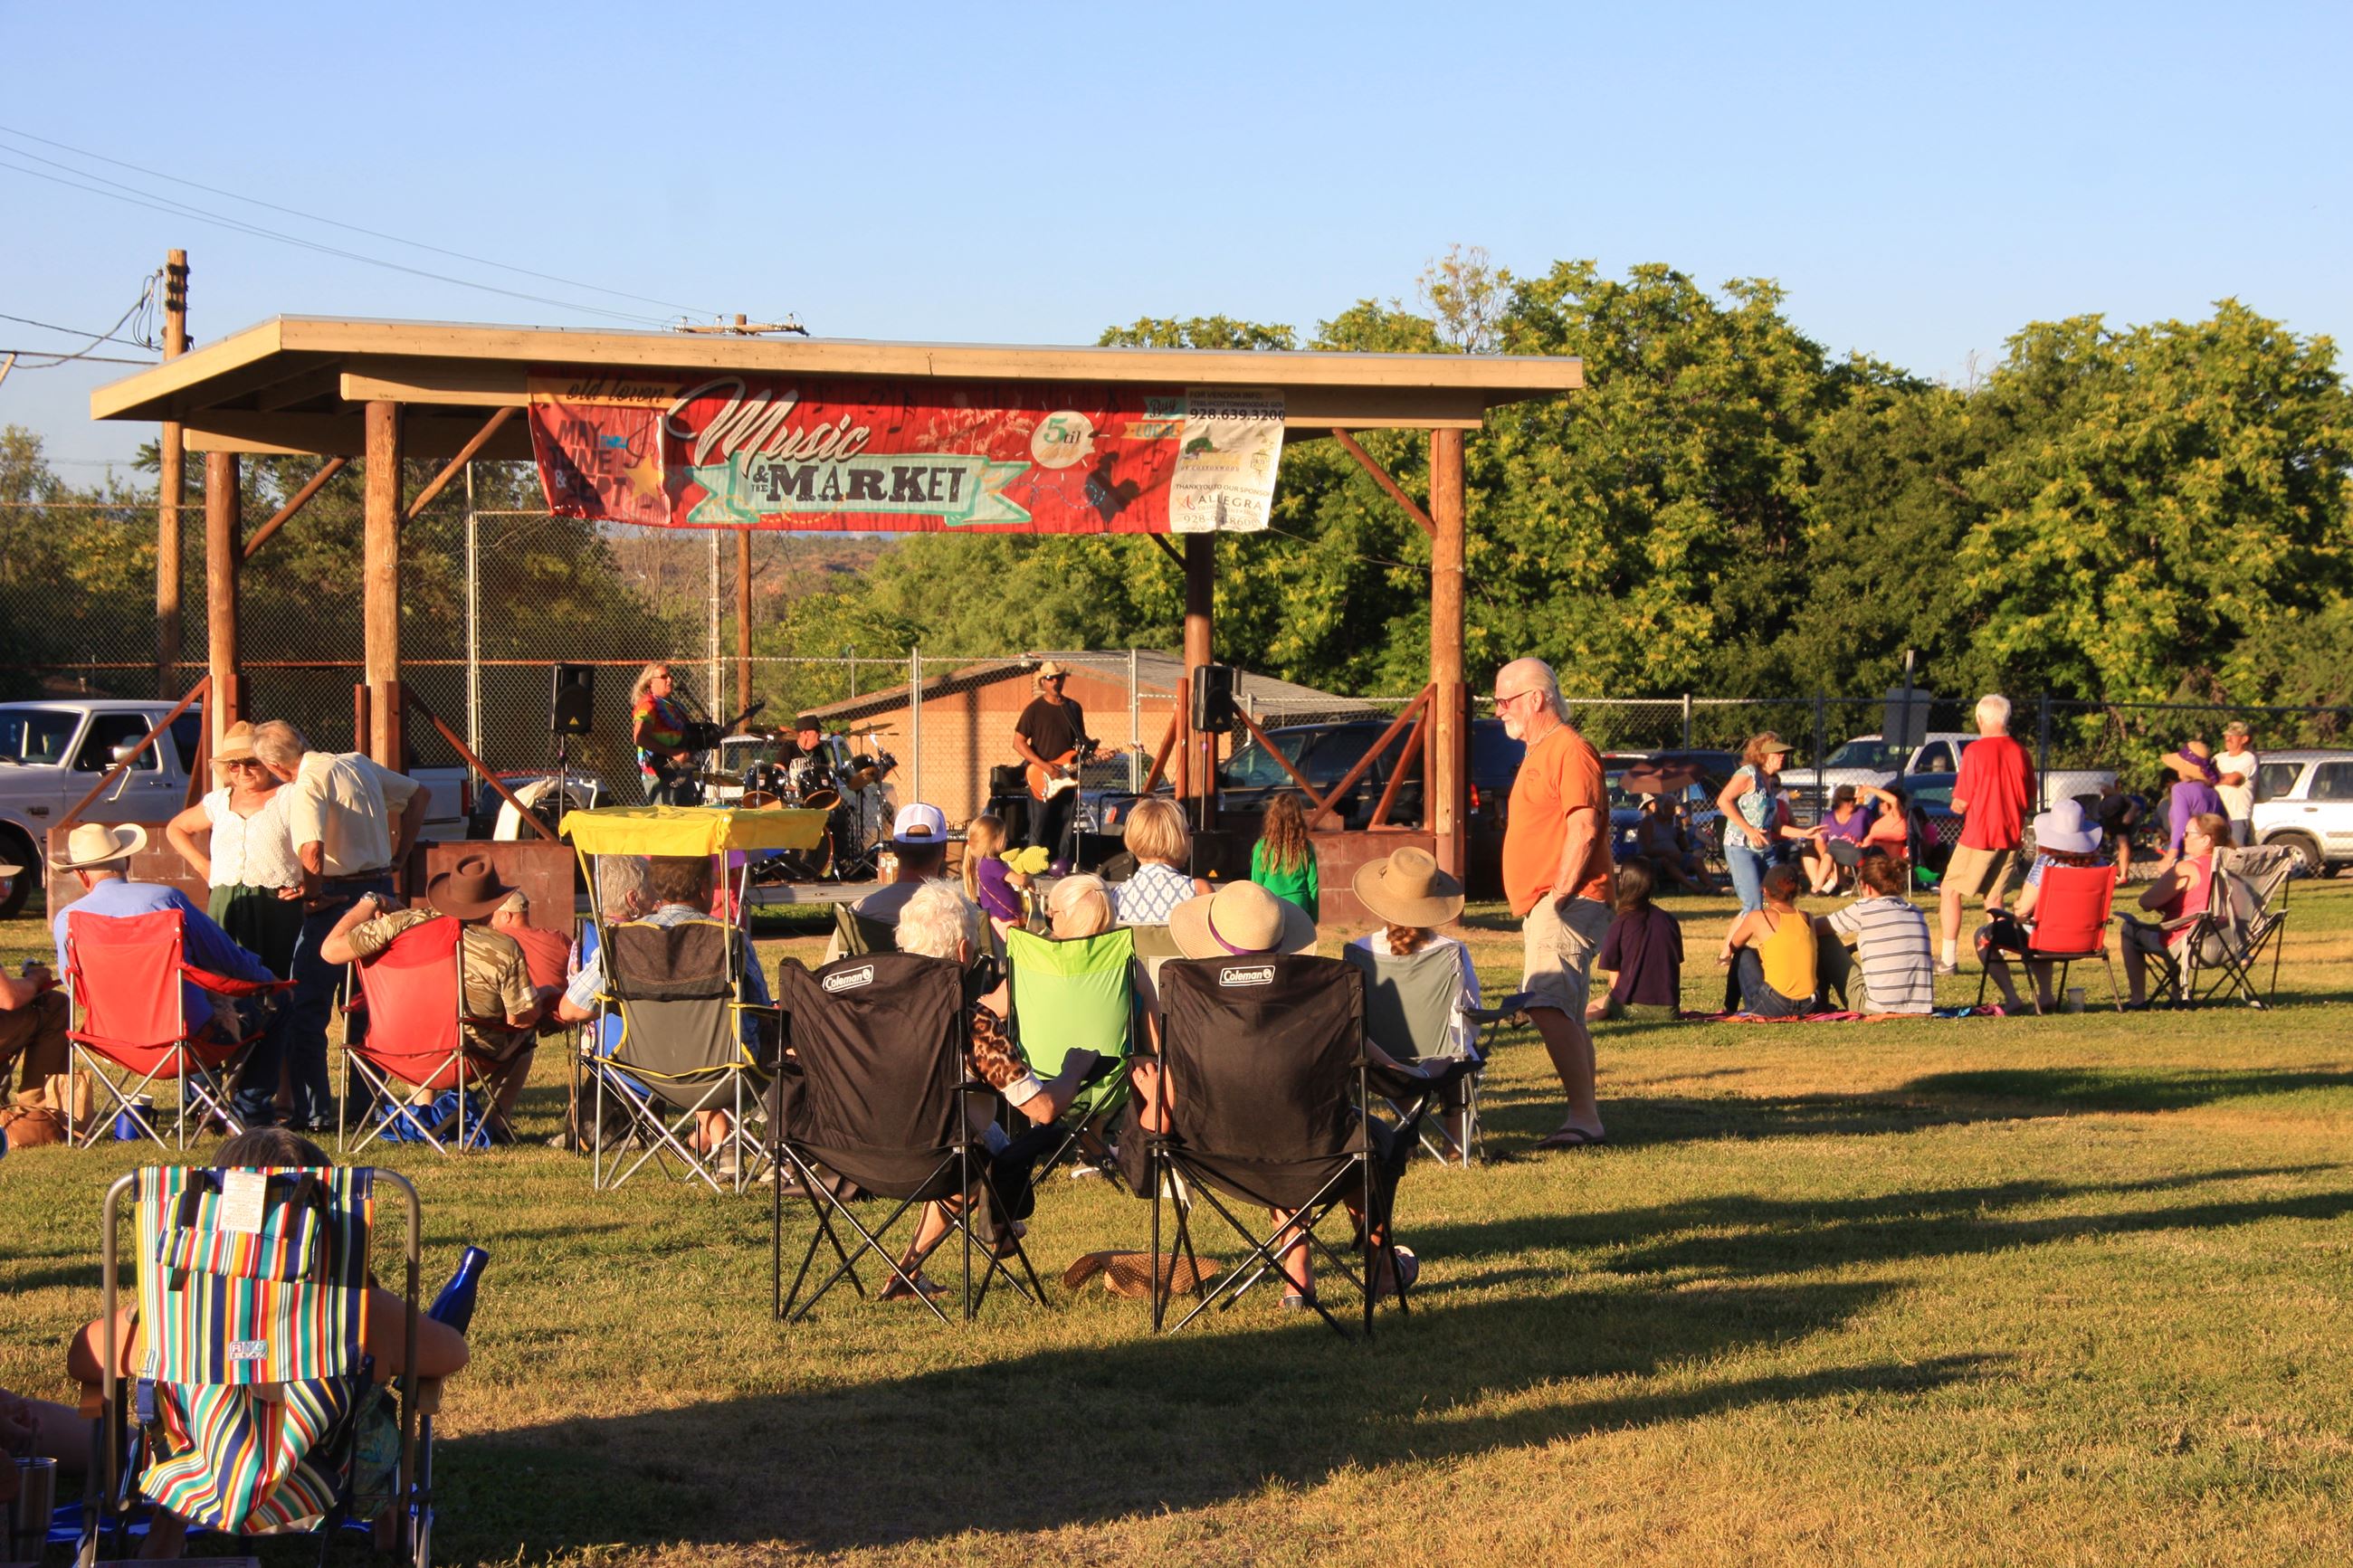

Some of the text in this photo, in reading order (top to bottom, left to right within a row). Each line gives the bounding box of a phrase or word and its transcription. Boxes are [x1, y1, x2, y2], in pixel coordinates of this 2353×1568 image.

[1148, 398, 1176, 419] Buy
[1189, 408, 1285, 422] 928.639.3200
[557, 420, 605, 450] MAY
[665, 376, 871, 479] Music
[1043, 418, 1081, 443] 5 til
[1135, 422, 1176, 438] LOCAL
[547, 446, 612, 475] JUNE
[555, 470, 567, 489] &
[753, 464, 769, 483] &
[751, 484, 767, 492] THE
[767, 464, 967, 503] MARKET
[1198, 495, 1262, 510] ALLEGRA
[825, 974, 862, 989] Coleman
[1224, 970, 1262, 982] Coleman
